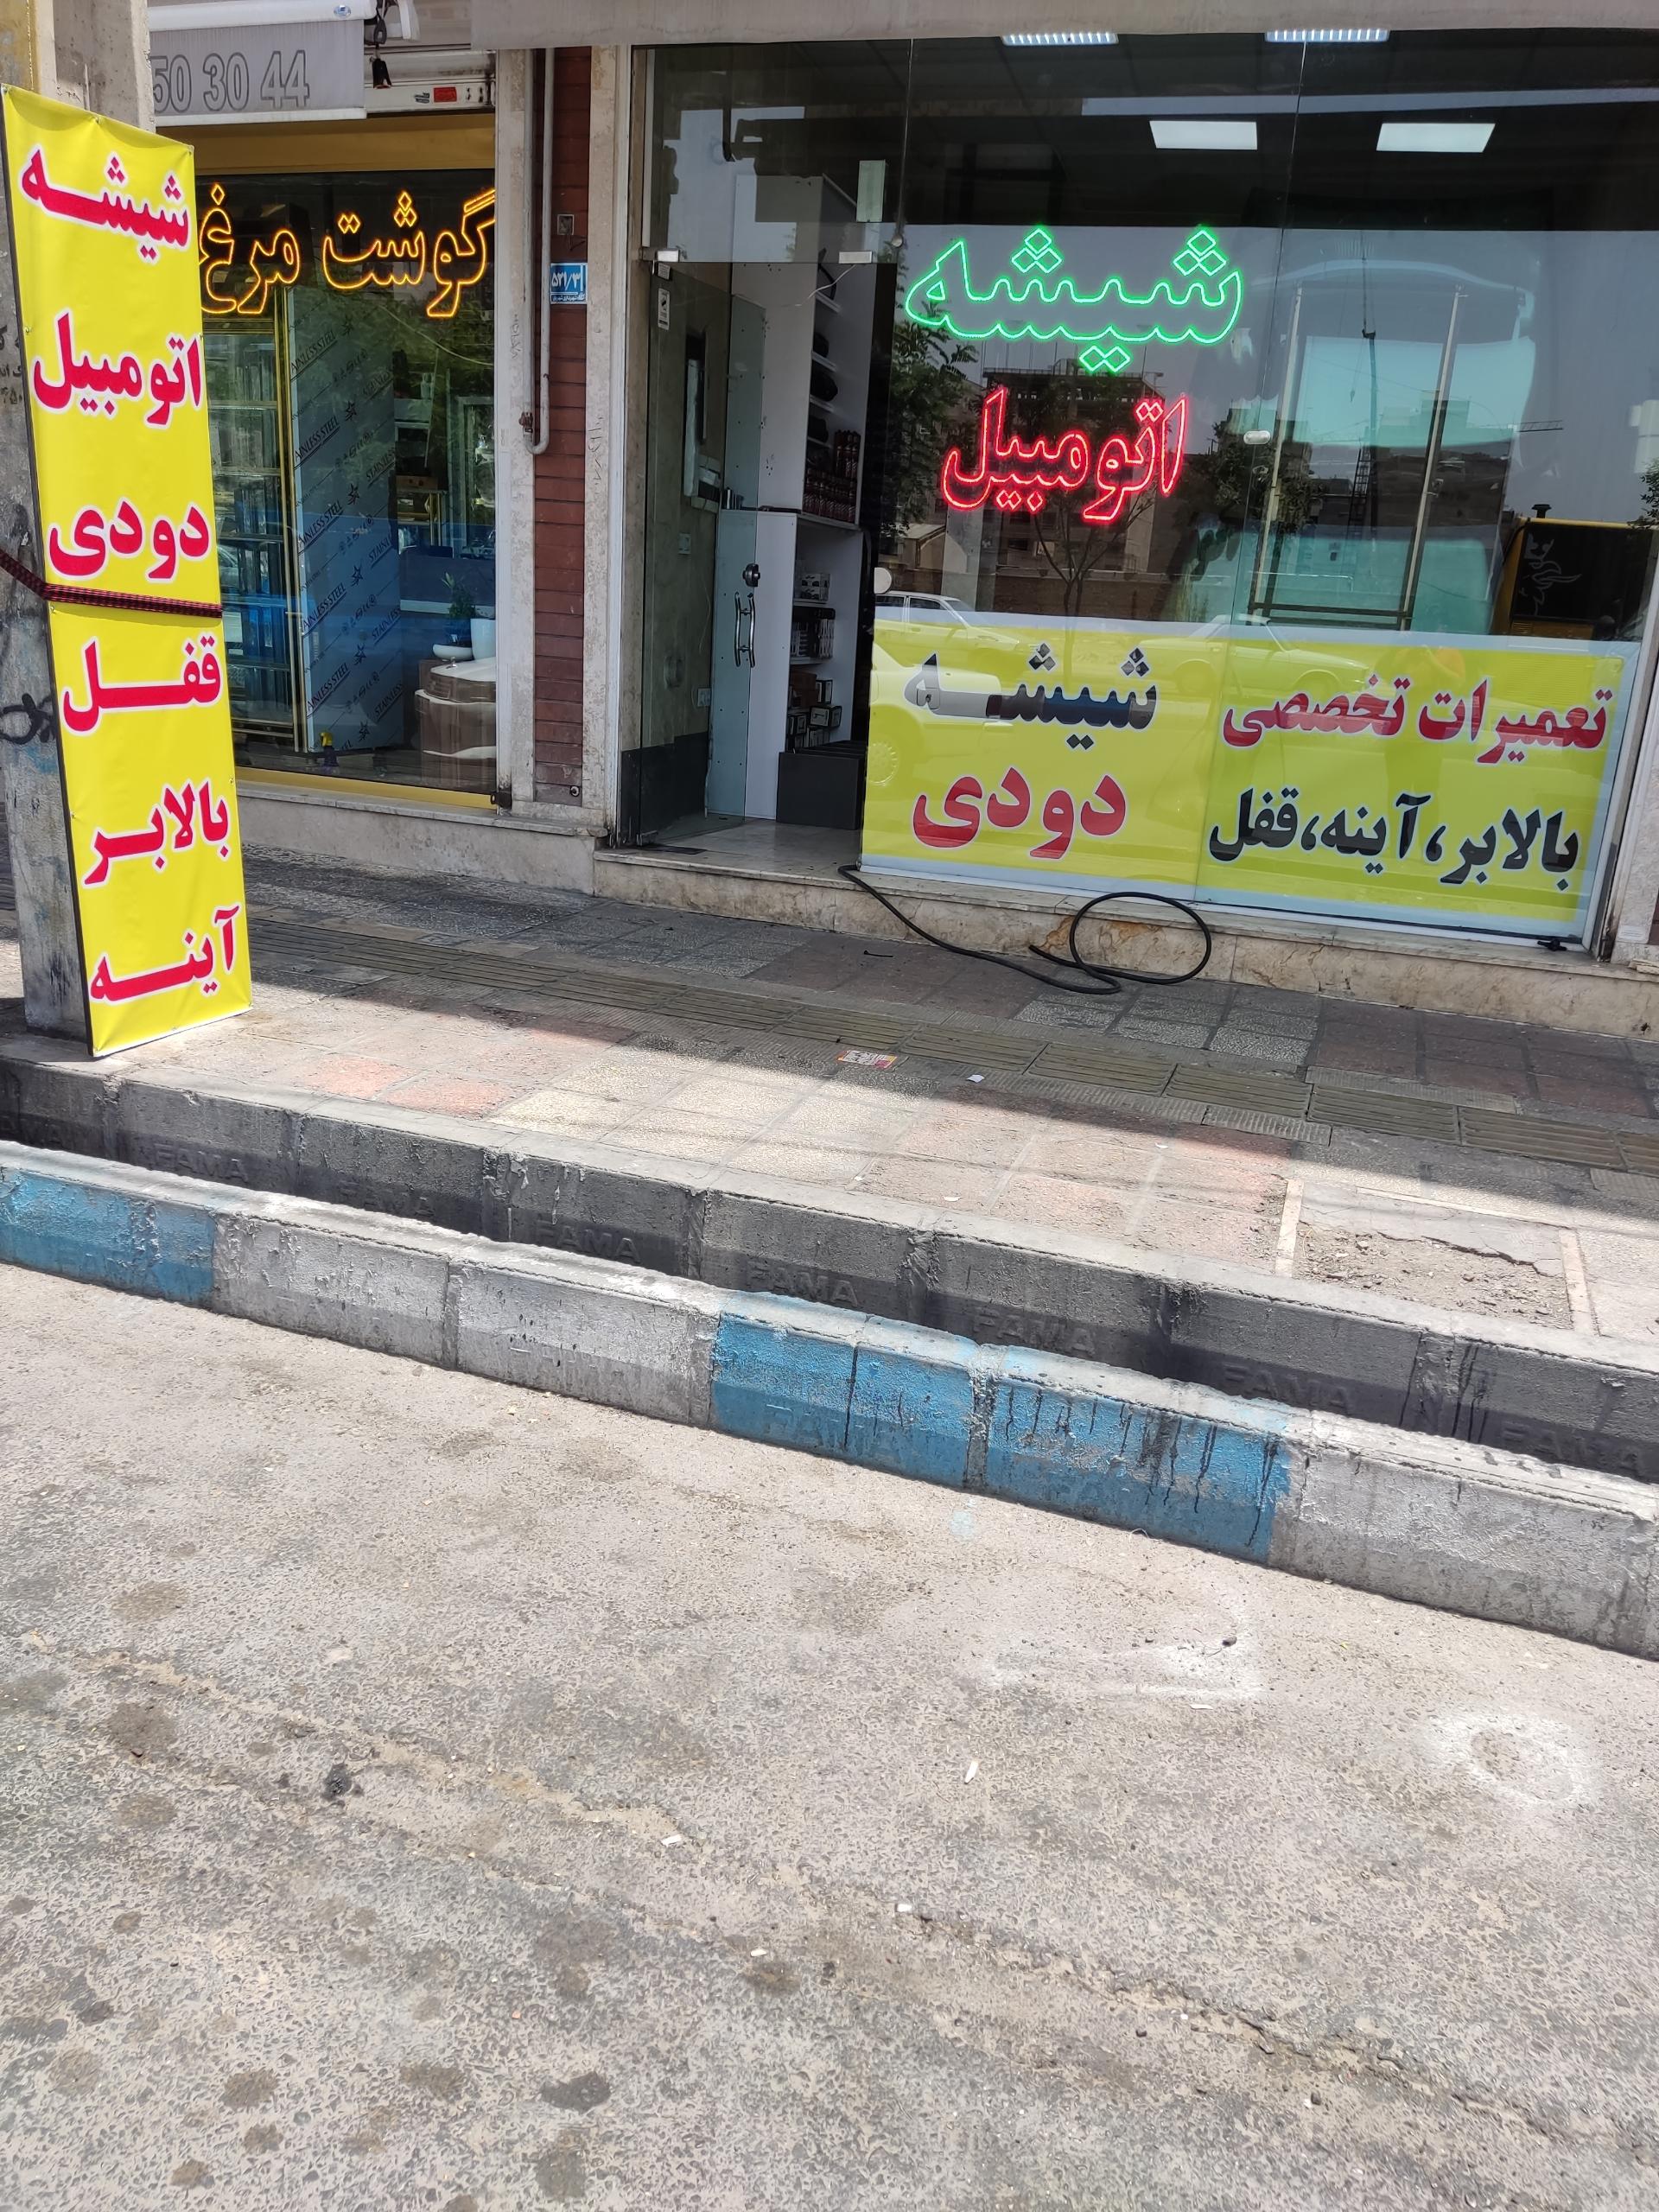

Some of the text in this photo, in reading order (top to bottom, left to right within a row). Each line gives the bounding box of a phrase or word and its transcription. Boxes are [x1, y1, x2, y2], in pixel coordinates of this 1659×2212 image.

[150, 48, 310, 113] 50 30 44
[21, 151, 190, 262] شیشه
[199, 182, 497, 318] گوشت مرغ
[904, 225, 1246, 375] شیشه
[32, 312, 202, 427] اتومبیل
[320, 415, 340, 436] STEEL
[939, 385, 1191, 527] اتومبیل
[48, 499, 210, 581] دودی
[323, 499, 343, 524] STEEL
[327, 582, 346, 606] STEEL
[62, 634, 222, 733] قفل
[331, 662, 350, 686] STEEL
[904, 643, 1158, 751] شیشه
[1223, 674, 1613, 764] تعمیرات تخصصی
[84, 781, 230, 886] بالابر
[912, 768, 1127, 859] دودی
[89, 905, 240, 1002] آینه
